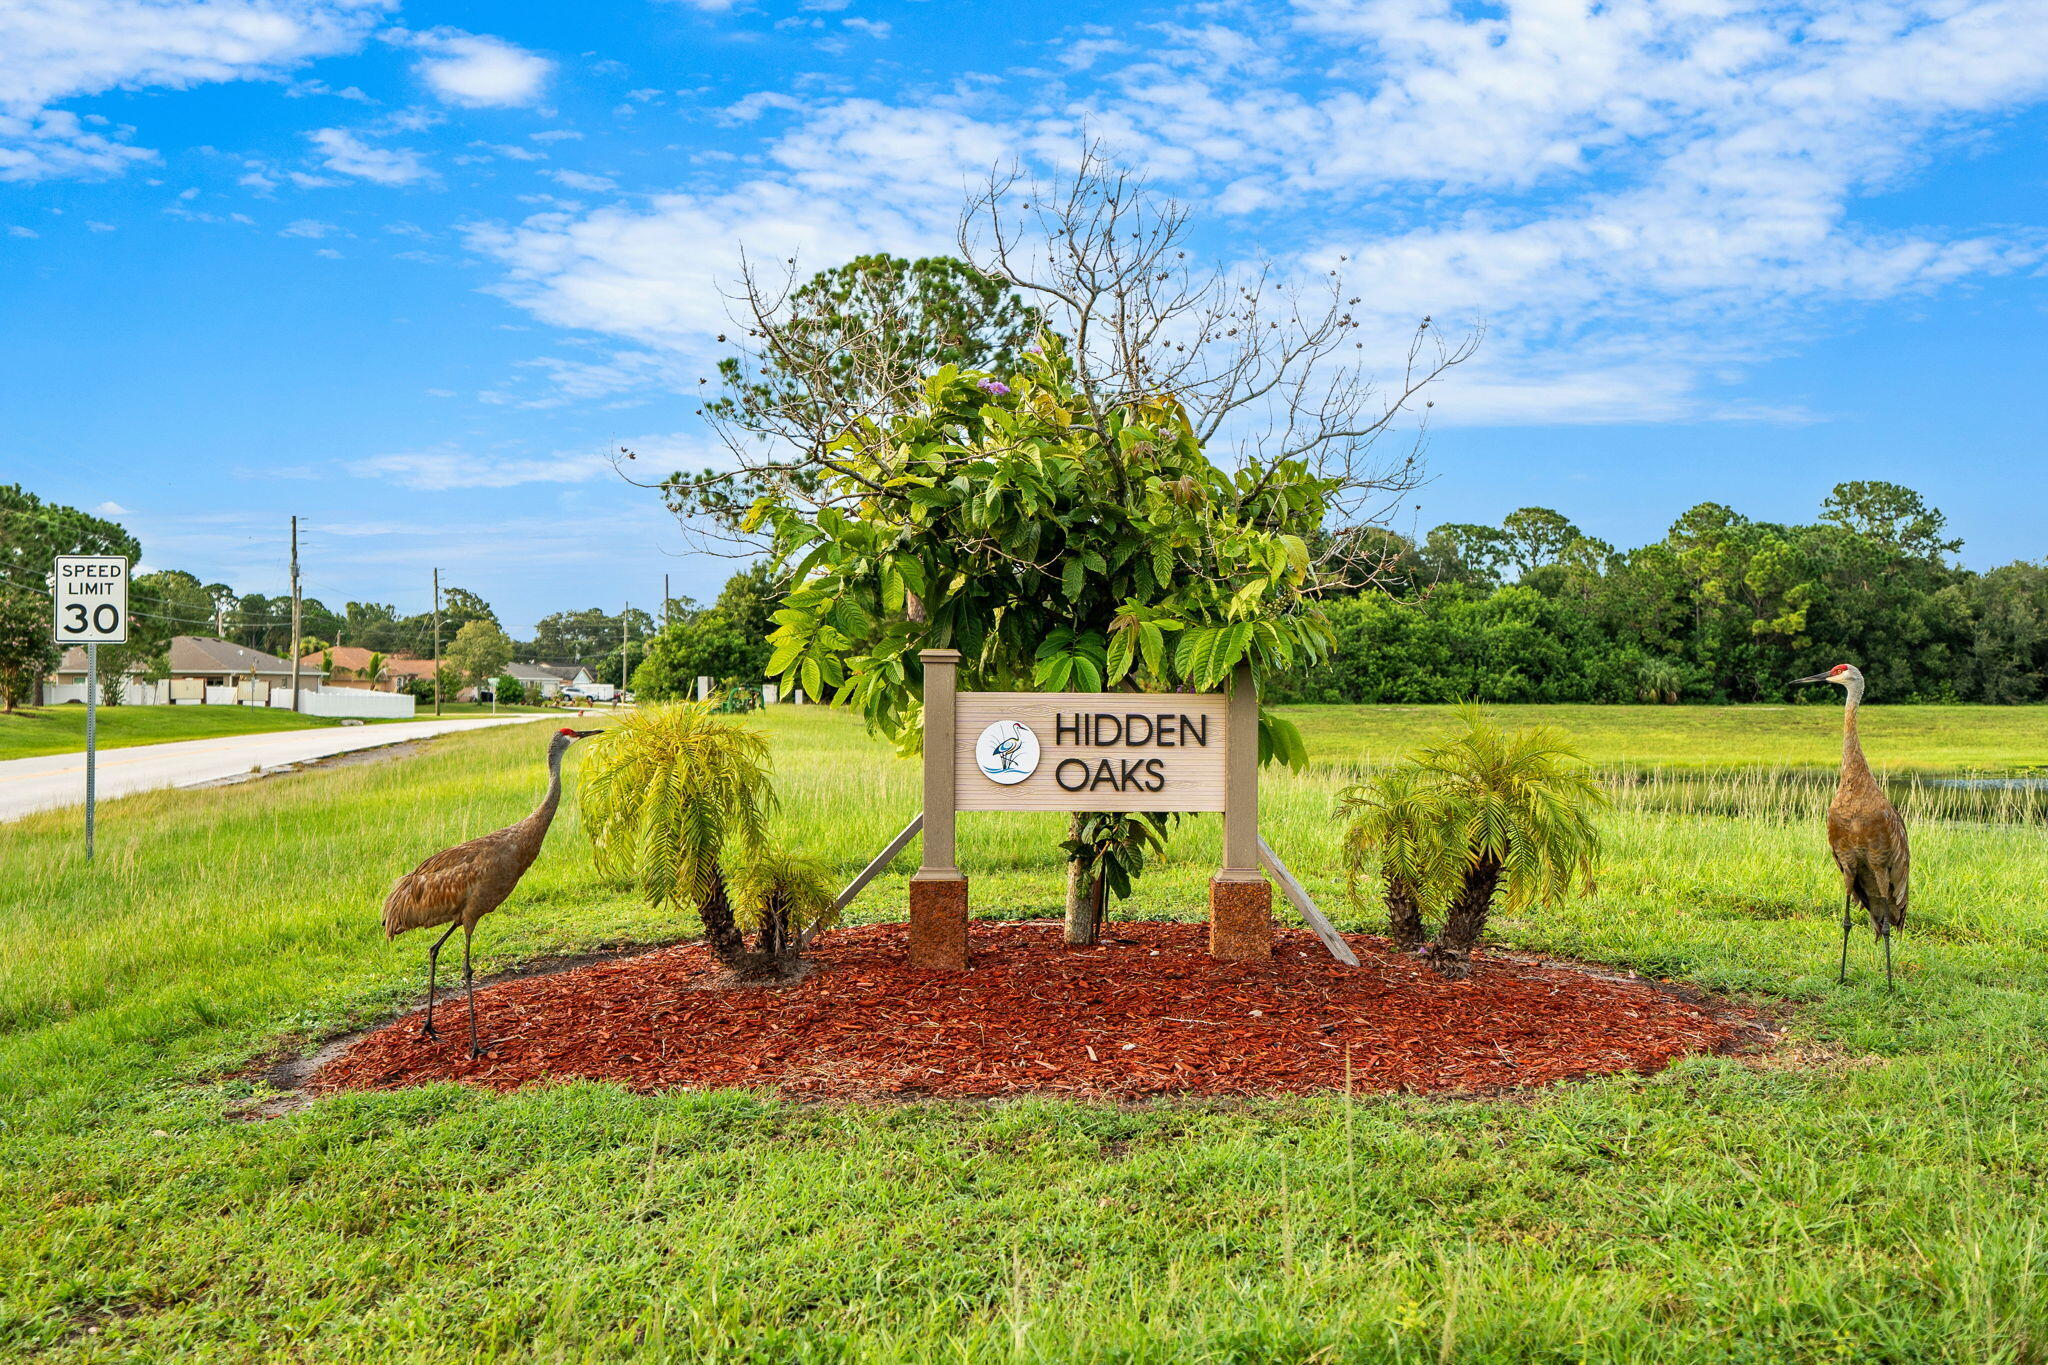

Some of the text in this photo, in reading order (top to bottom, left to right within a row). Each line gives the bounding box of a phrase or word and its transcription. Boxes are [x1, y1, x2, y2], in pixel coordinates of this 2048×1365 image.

[62, 564, 121, 577] SPEED
[68, 582, 114, 595] LIMIT
[63, 603, 119, 634] 30
[1056, 713, 1207, 747] HIDDEN
[1055, 758, 1165, 792] OAKS
